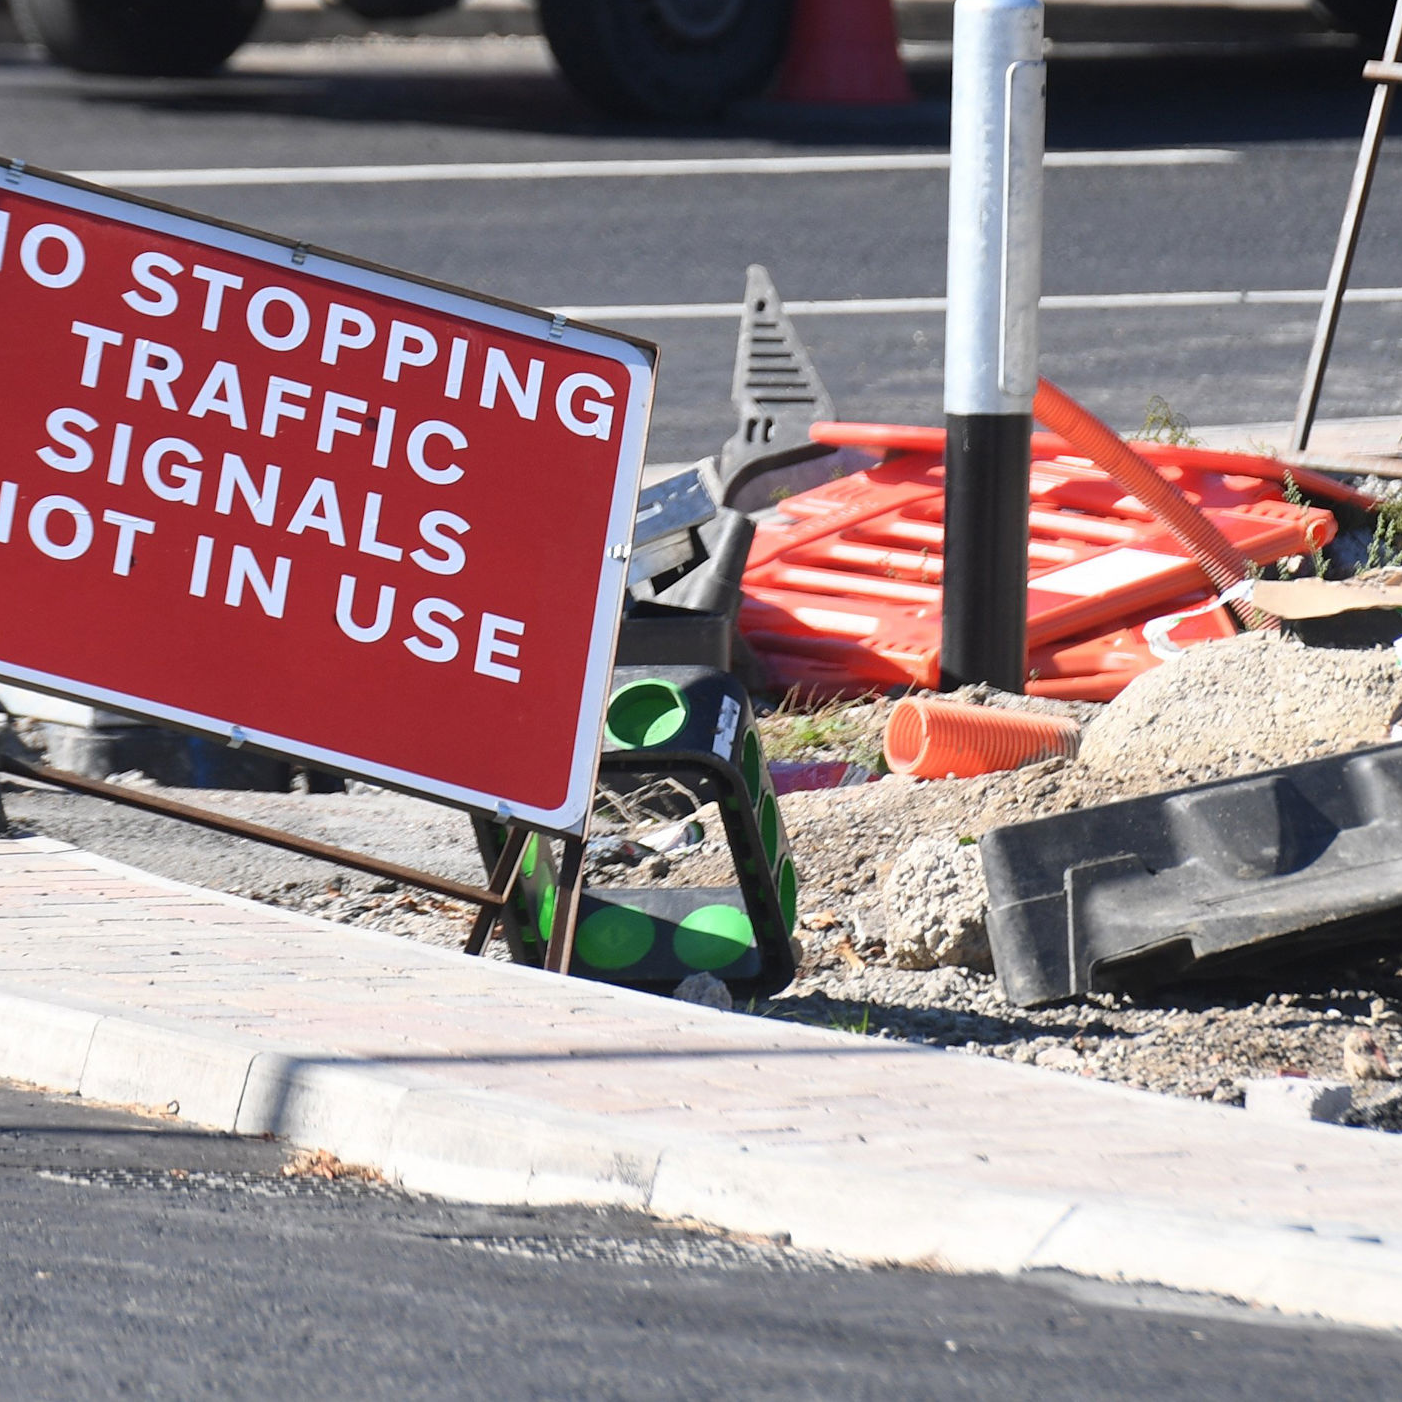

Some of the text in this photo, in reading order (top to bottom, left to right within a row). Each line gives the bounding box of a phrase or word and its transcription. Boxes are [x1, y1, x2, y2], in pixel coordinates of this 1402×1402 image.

[71, 320, 469, 485] TRAFFIC
[121, 251, 615, 442] STOPPING
[35, 407, 471, 576] SIGNALS
[188, 534, 292, 619] IN
[335, 574, 525, 684] USE
